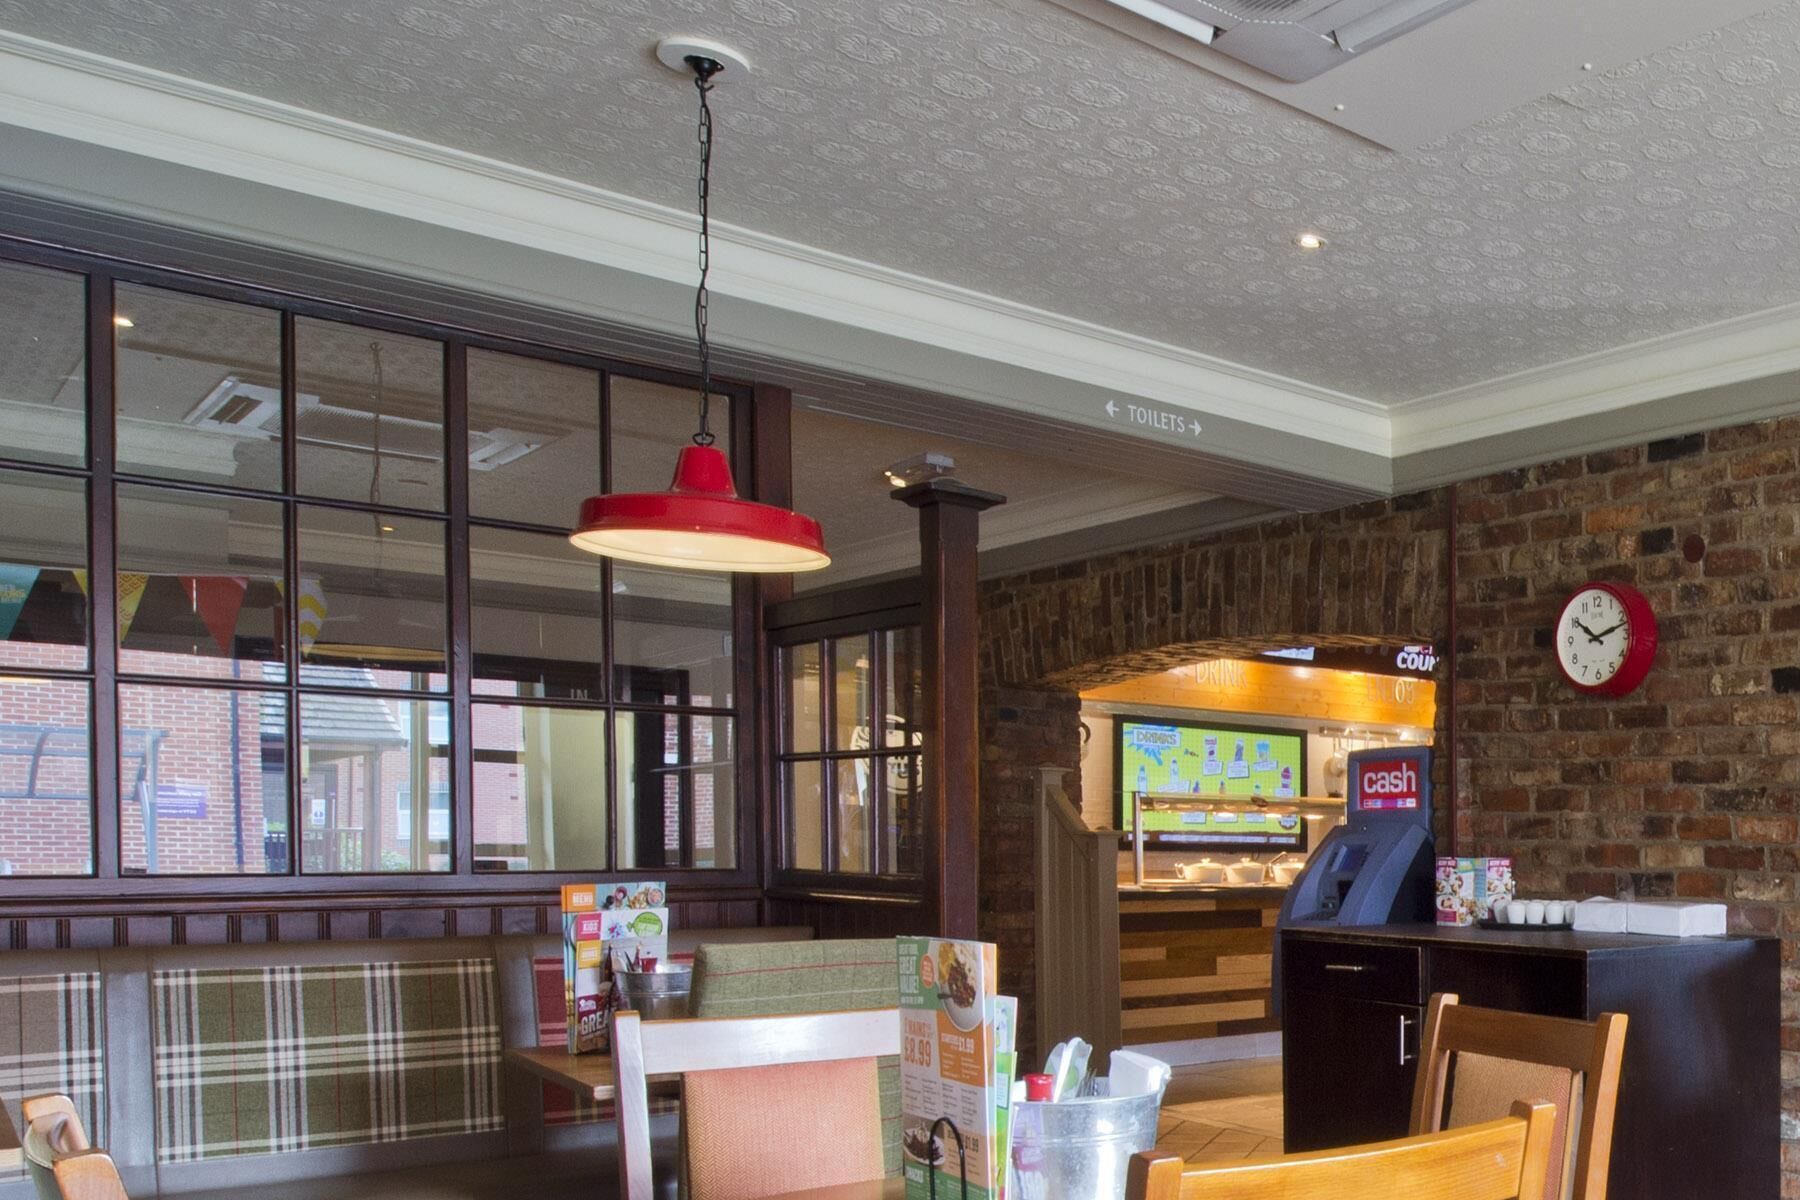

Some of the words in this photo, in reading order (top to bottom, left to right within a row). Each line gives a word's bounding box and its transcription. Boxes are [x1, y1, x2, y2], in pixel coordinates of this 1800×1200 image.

[1127, 404, 1185, 433] TOILETS
[1582, 602, 1588, 614] 11
[1593, 596, 1602, 608] 12
[1567, 636, 1574, 647] 9
[1572, 653, 1578, 664] 8
[1582, 665, 1588, 677] 7
[1595, 668, 1602, 680] 6
[1609, 662, 1615, 674] 5
[1363, 762, 1416, 793] cash
[904, 1035, 932, 1067] £8.99
